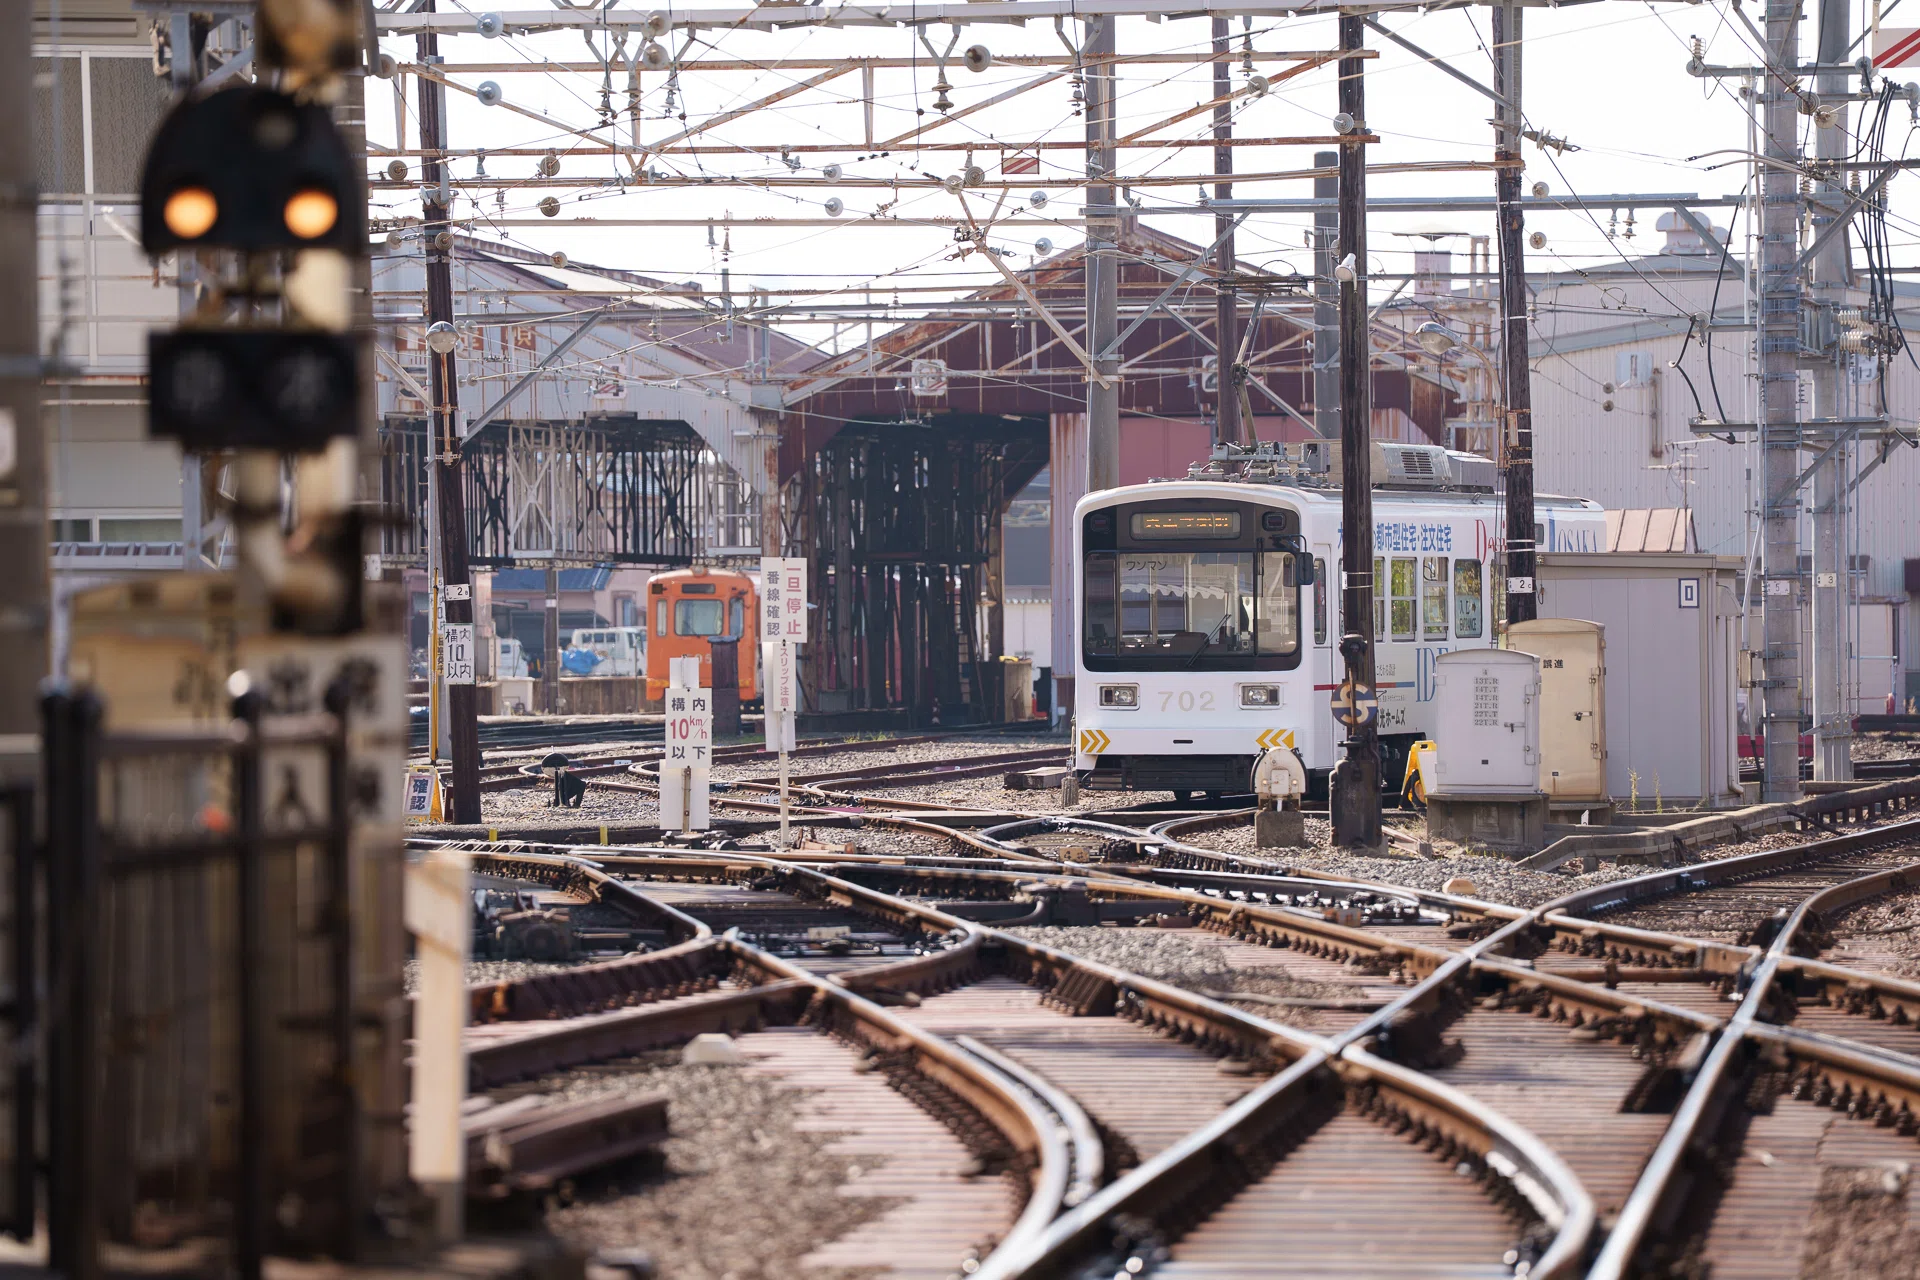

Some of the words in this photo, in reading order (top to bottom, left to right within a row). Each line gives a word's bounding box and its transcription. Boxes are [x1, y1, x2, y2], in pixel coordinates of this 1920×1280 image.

[1126, 561, 1167, 571] ワンマン
[457, 586, 463, 596] 2
[1519, 579, 1525, 589] 2
[766, 571, 780, 636] 番線確認
[786, 567, 802, 635] 一旦停止
[445, 627, 471, 643] 構内
[446, 662, 472, 678] 以内
[780, 648, 790, 707] スリップ注意
[671, 698, 706, 711] 構内
[1157, 690, 1216, 712] 702
[671, 746, 706, 759] 以下
[410, 779, 428, 810] 確認
